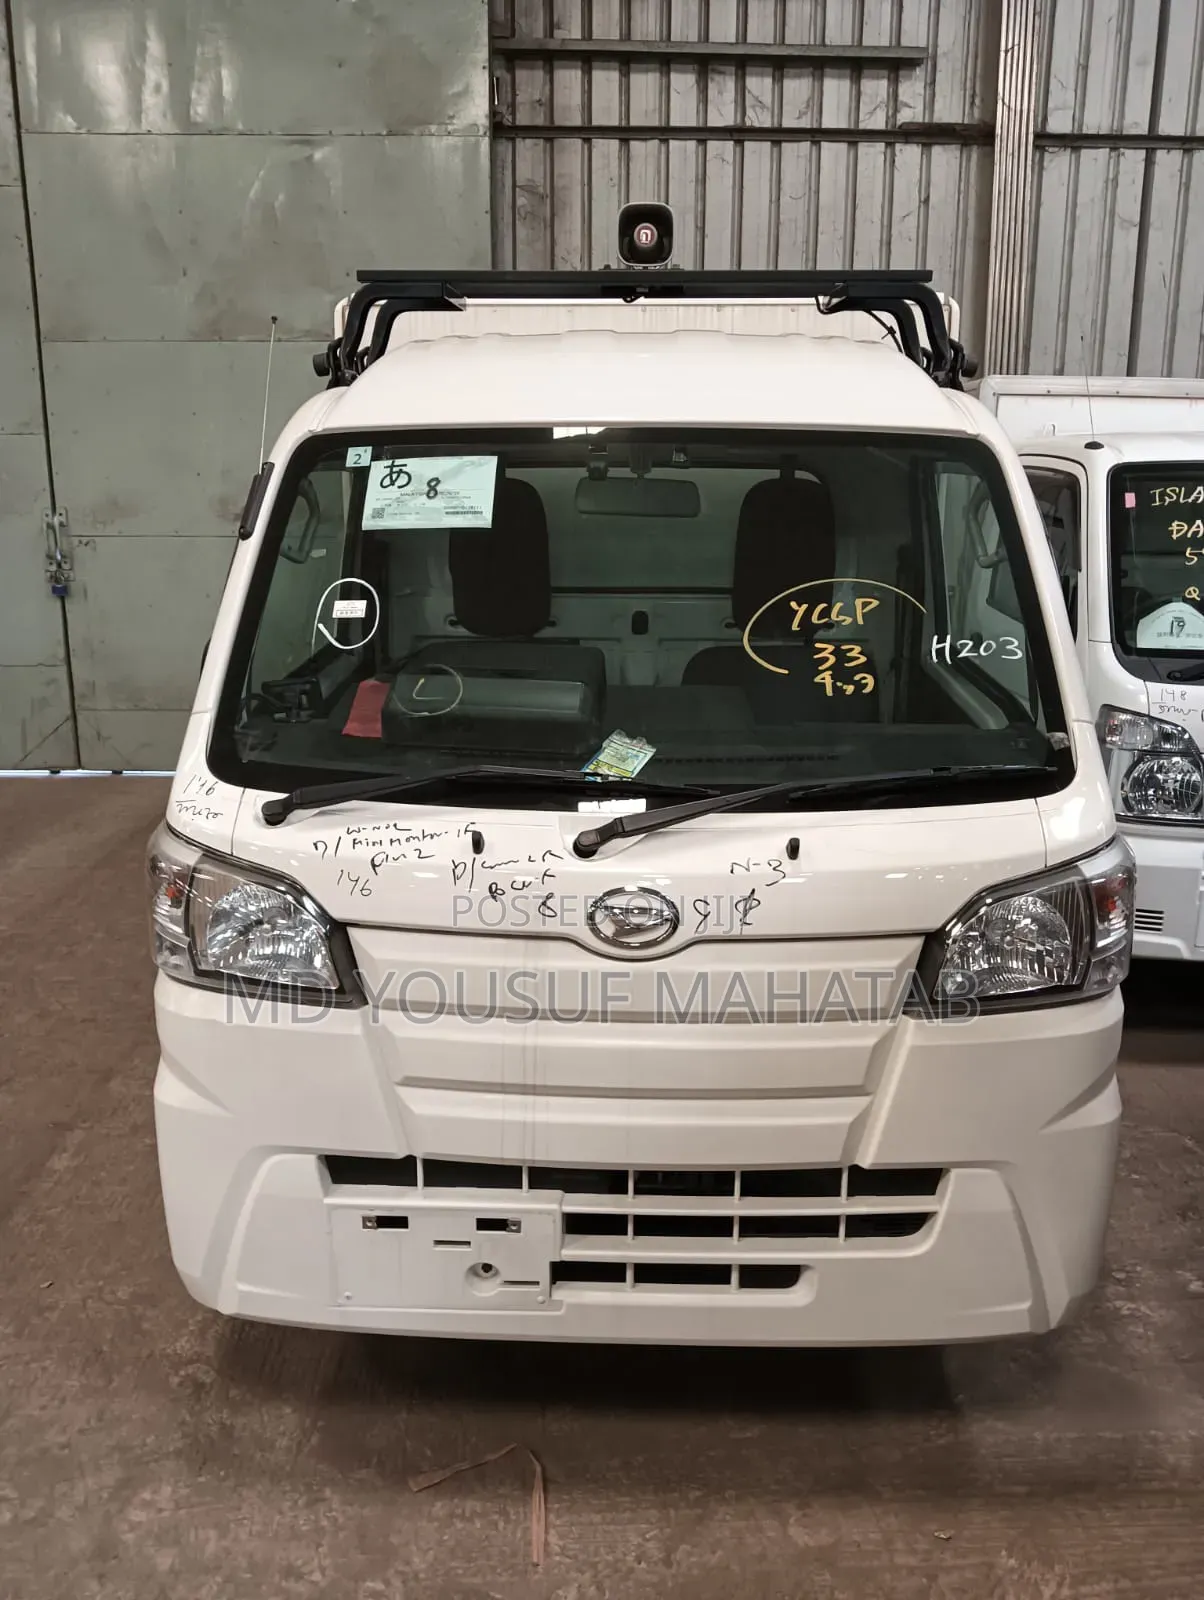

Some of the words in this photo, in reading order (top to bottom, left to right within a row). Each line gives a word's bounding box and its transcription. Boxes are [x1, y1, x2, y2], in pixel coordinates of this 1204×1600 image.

[353, 453, 362, 464] 2
[380, 460, 412, 489] あ
[426, 477, 441, 499] 8
[813, 642, 868, 670] 33
[931, 634, 1024, 664] H203
